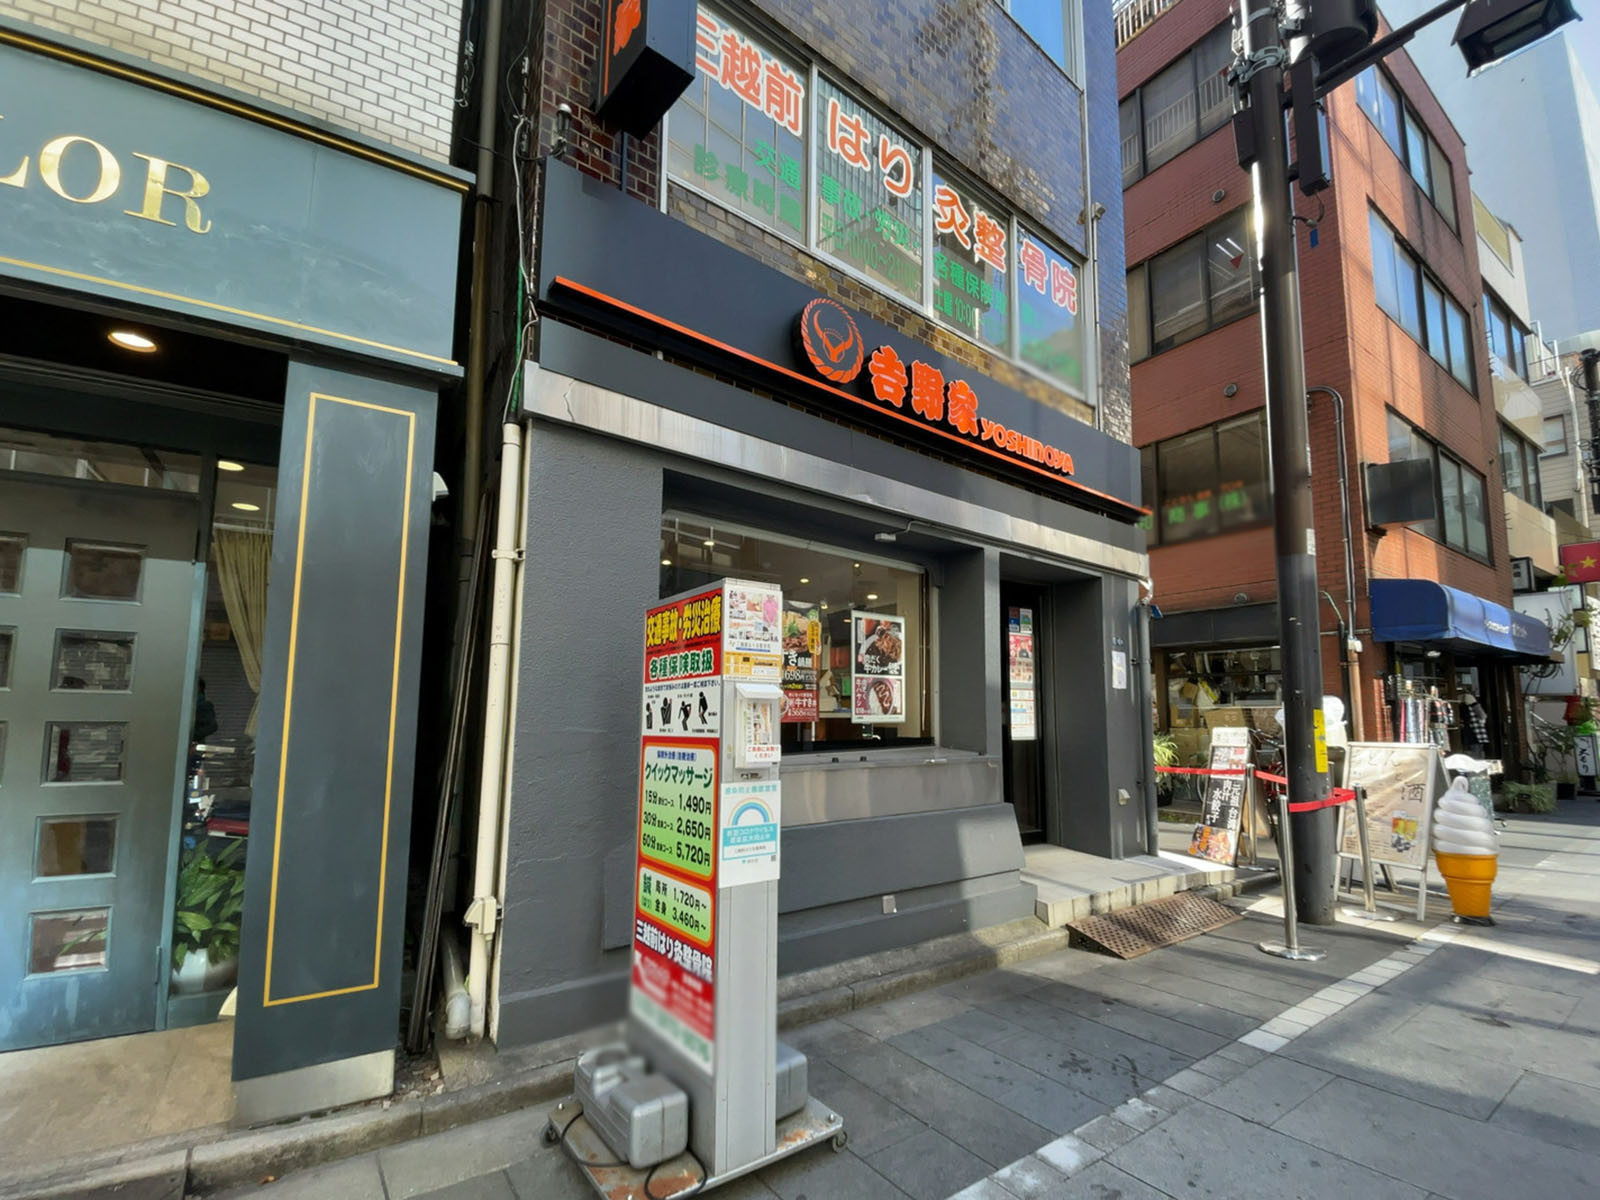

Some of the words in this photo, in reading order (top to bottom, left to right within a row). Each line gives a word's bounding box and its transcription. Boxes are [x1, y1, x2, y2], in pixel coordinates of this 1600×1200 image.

[696, 12, 804, 136] 三越前
[826, 97, 914, 198] はり
[650, 647, 714, 680] 各種保険取扱
[644, 762, 713, 789] クイックマッサージ
[678, 793, 712, 816] 1,490円
[676, 816, 711, 841] 2,650円
[676, 841, 711, 867] 5,720円
